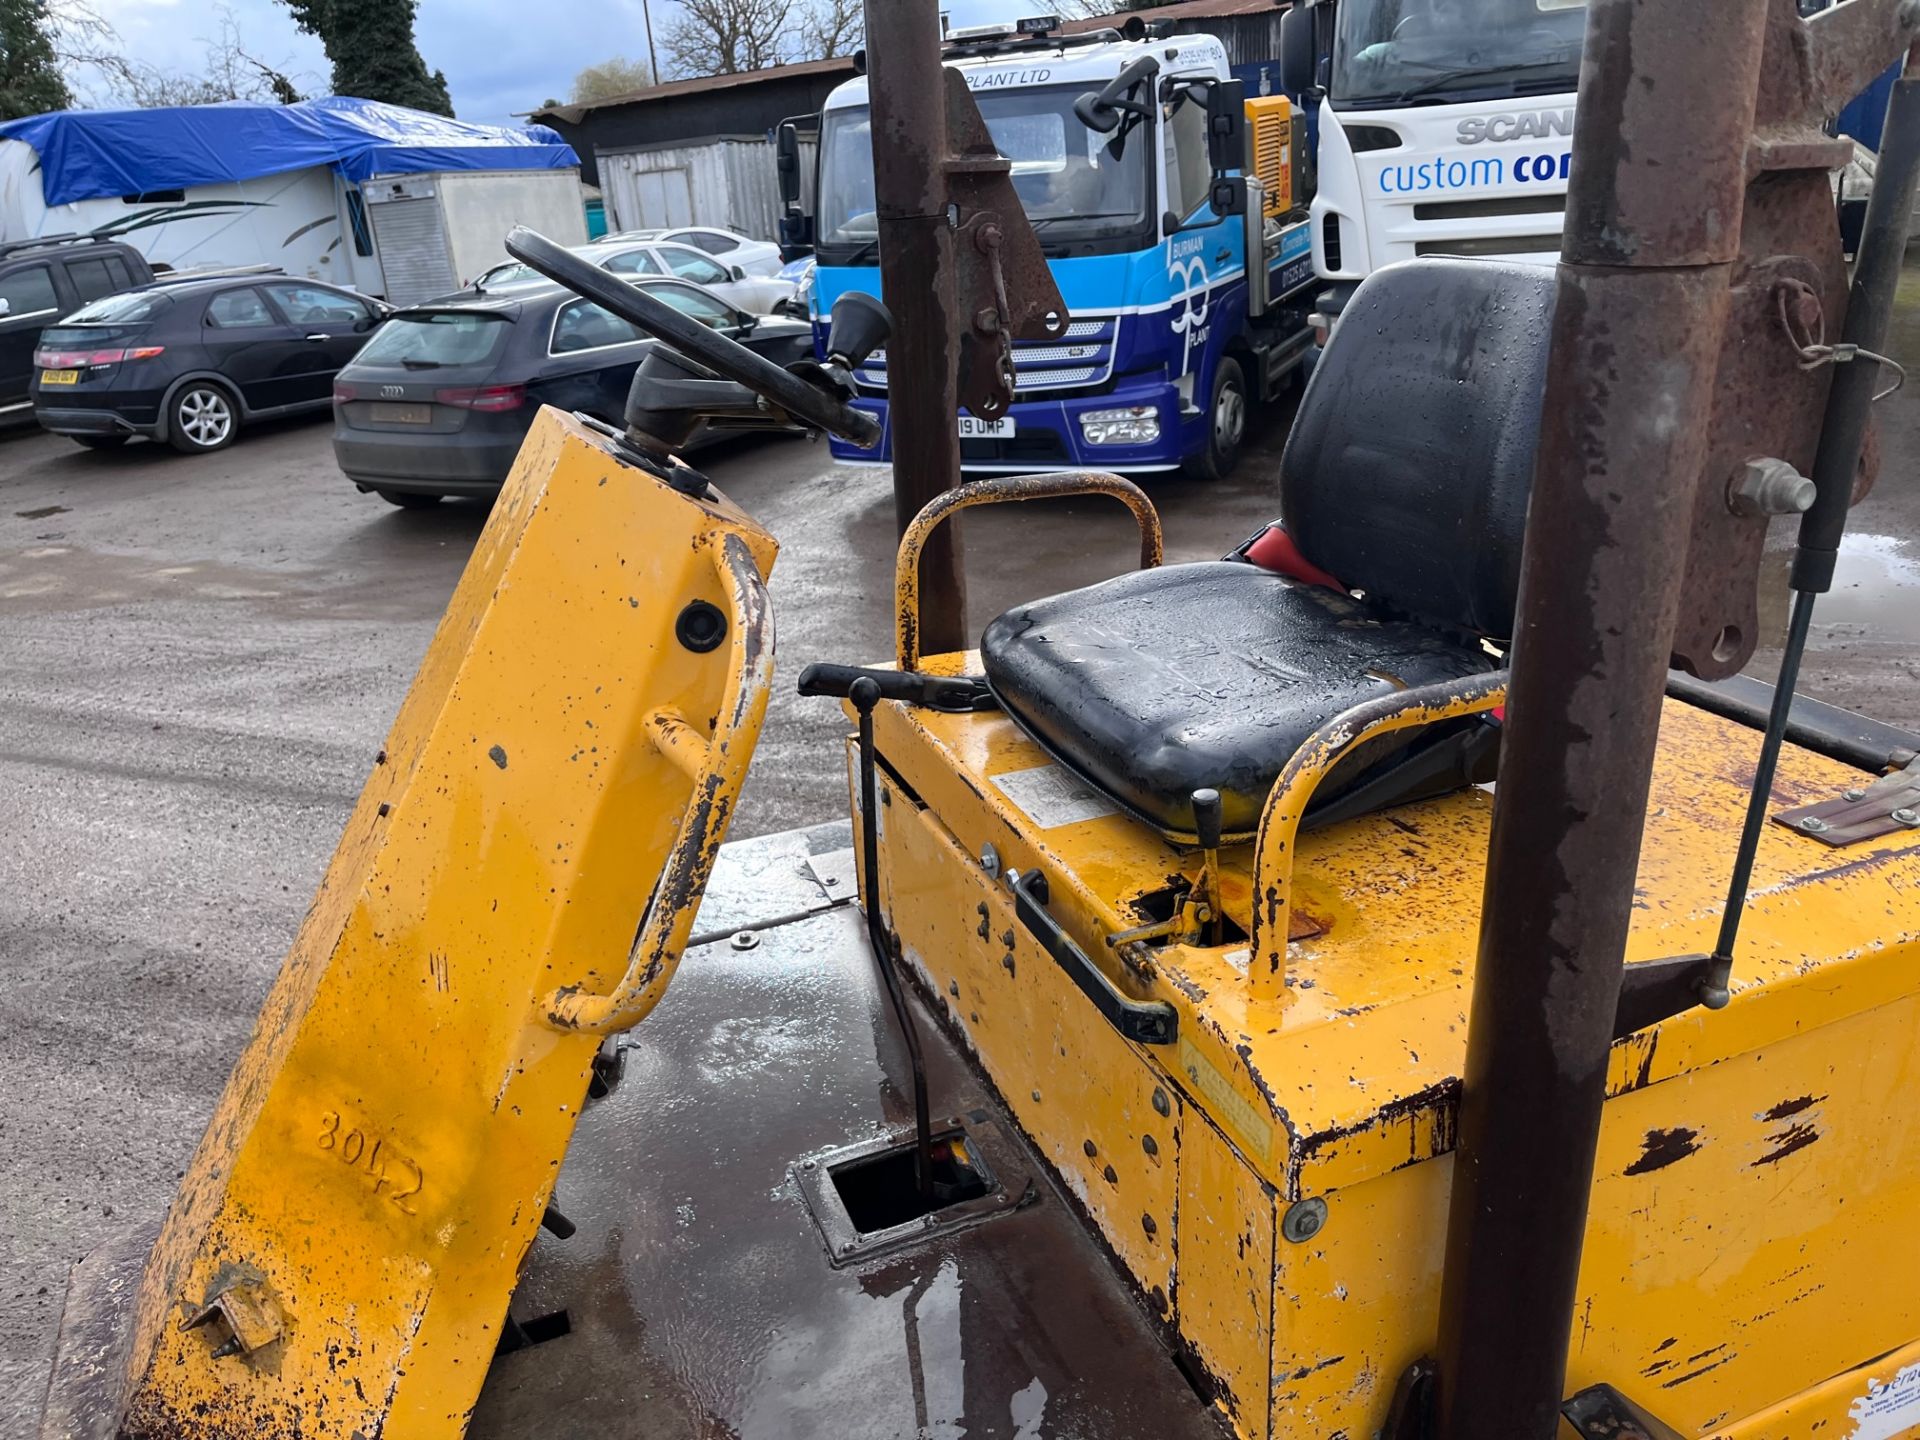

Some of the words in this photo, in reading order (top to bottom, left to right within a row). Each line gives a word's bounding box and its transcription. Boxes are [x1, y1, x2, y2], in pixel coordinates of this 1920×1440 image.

[966, 70, 1018, 89] PLANT
[1020, 68, 1051, 84] LTD
[1380, 157, 1503, 193] custom
[1173, 235, 1204, 259] BURMAN
[1189, 325, 1211, 348] PLANT
[960, 419, 973, 434] 19
